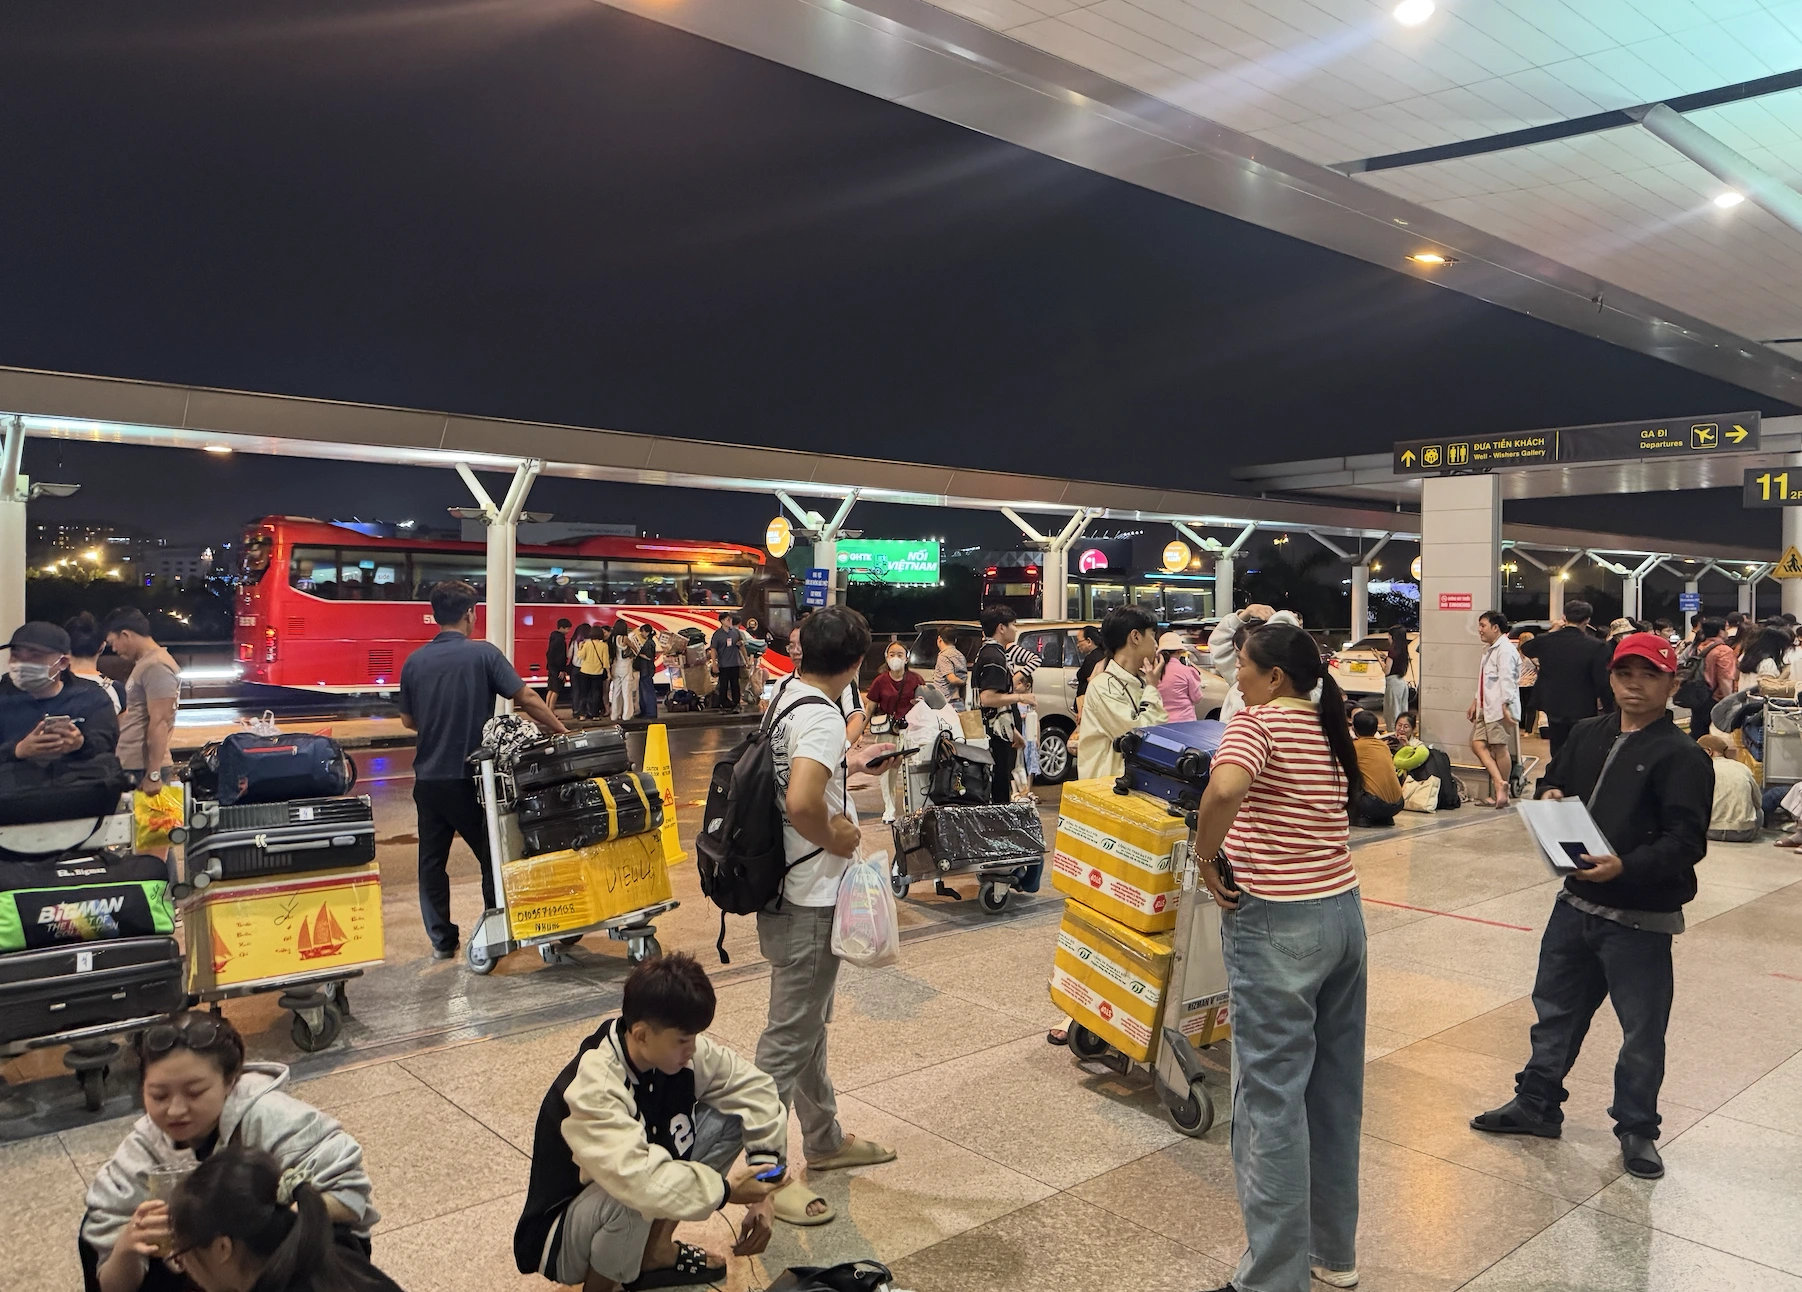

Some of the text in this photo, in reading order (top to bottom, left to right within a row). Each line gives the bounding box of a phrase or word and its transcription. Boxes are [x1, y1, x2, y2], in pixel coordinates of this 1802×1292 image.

[1640, 429, 1668, 438] GA ĐI
[1514, 437, 1545, 447] KHÁCH
[1639, 440, 1684, 450] Departures
[1493, 450, 1520, 459] Wishers
[1521, 448, 1546, 457] Gallery
[1756, 473, 1788, 501] 11
[849, 552, 872, 561] GHTK
[907, 549, 928, 561] NỐI
[47, 921, 67, 933] THE
[96, 914, 109, 925] OF
[669, 1112, 695, 1157] 2
